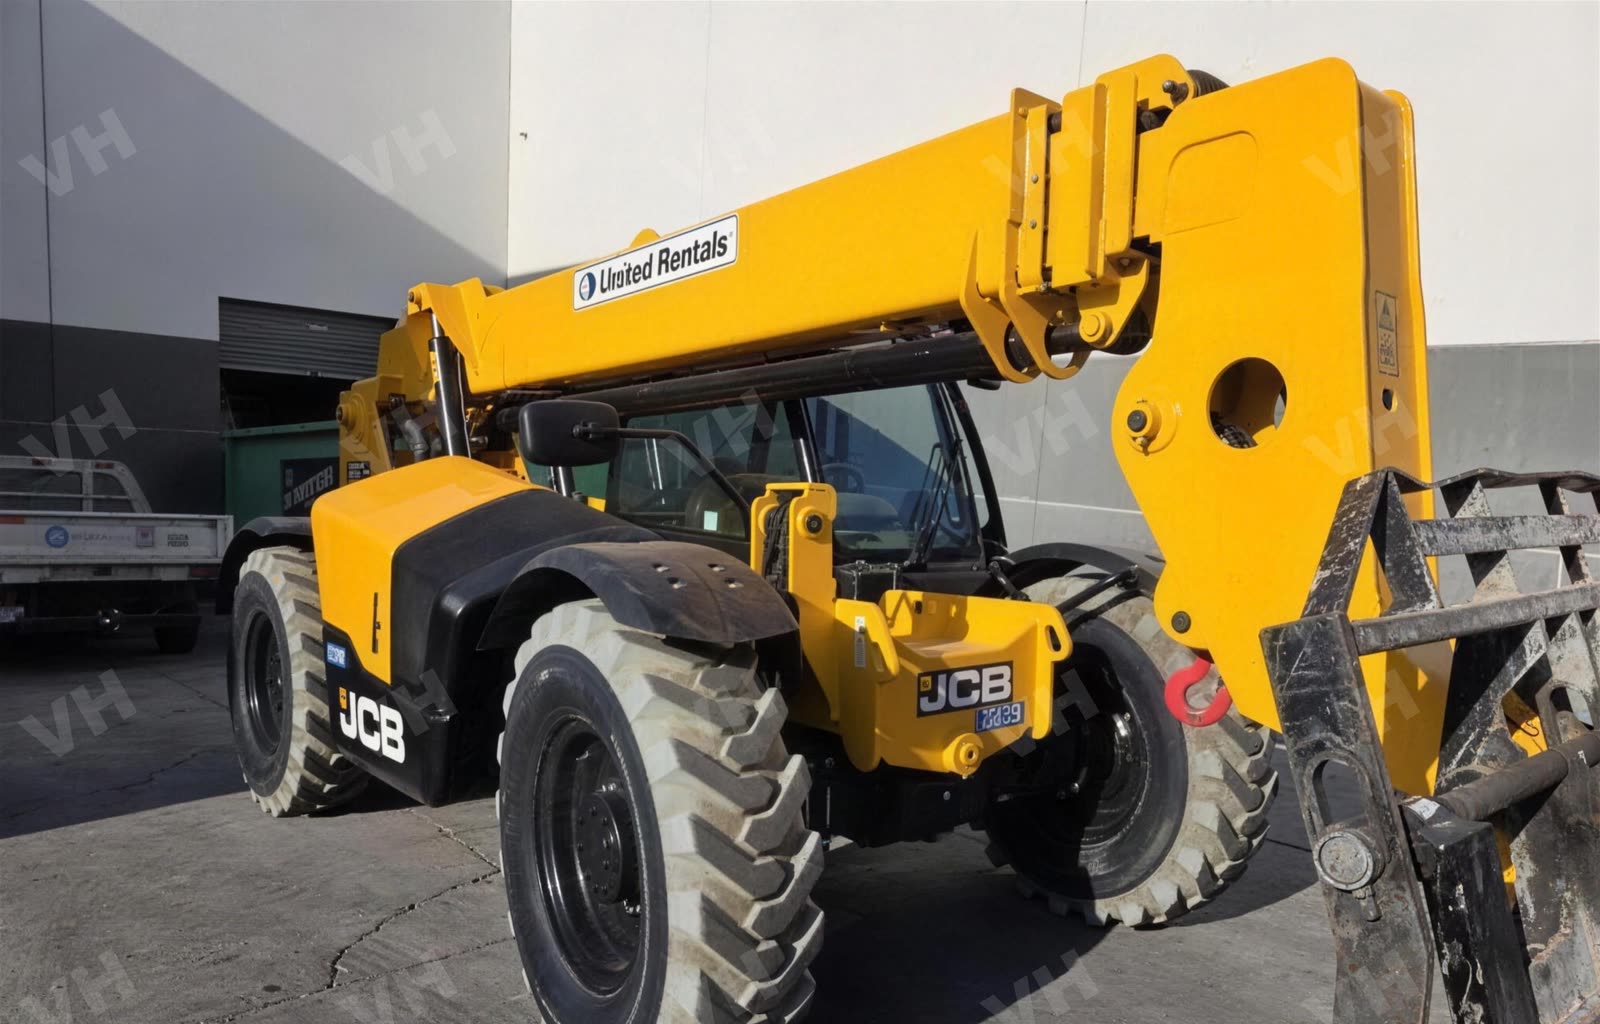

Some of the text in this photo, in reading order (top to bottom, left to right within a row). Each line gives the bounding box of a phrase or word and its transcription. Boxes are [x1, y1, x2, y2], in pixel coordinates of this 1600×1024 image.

[657, 231, 729, 276] Rentals
[920, 665, 1012, 712] JCB
[339, 690, 406, 764] JCB
